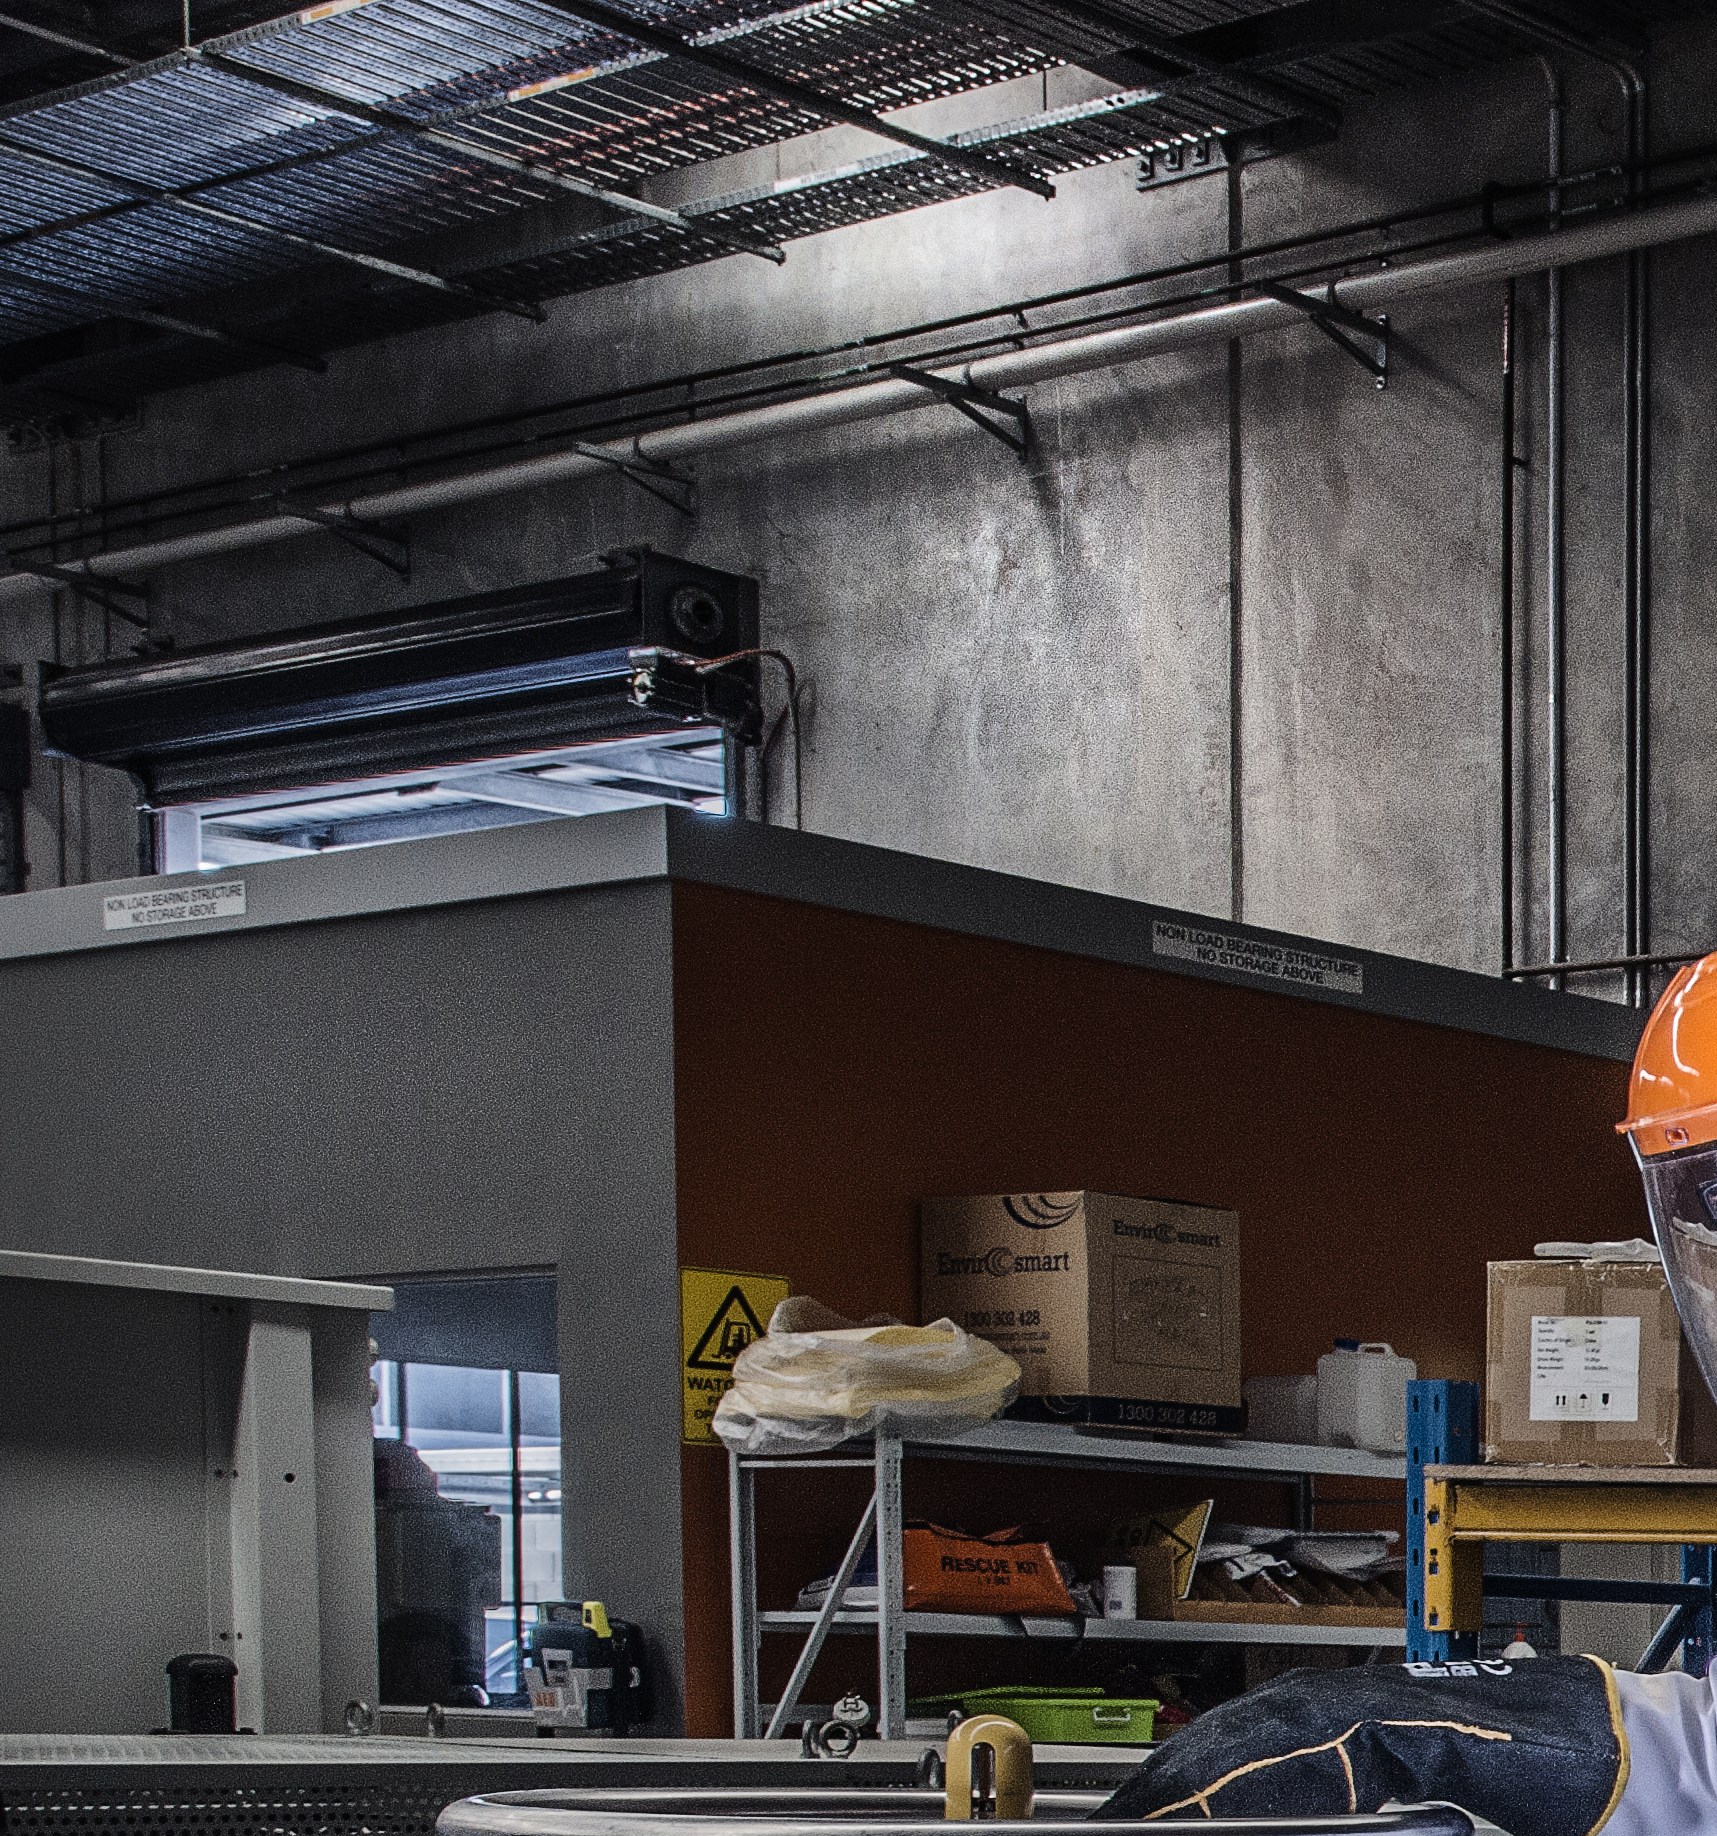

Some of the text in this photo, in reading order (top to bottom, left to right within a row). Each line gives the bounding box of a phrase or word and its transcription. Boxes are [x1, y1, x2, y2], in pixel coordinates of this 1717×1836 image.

[152, 890, 189, 907] BEARING
[191, 884, 243, 902] STRUCTURE
[132, 902, 218, 923] NO STORAGE ABOVE
[1156, 924, 1363, 977] NON LOAD BEARING STRUCTURE
[1197, 948, 1325, 985] NO STORAGE ABOVE
[687, 1376, 736, 1392] WATC
[1118, 1403, 1217, 1427] 1300 302 428
[940, 1555, 1039, 1576] RESCUE KIT
